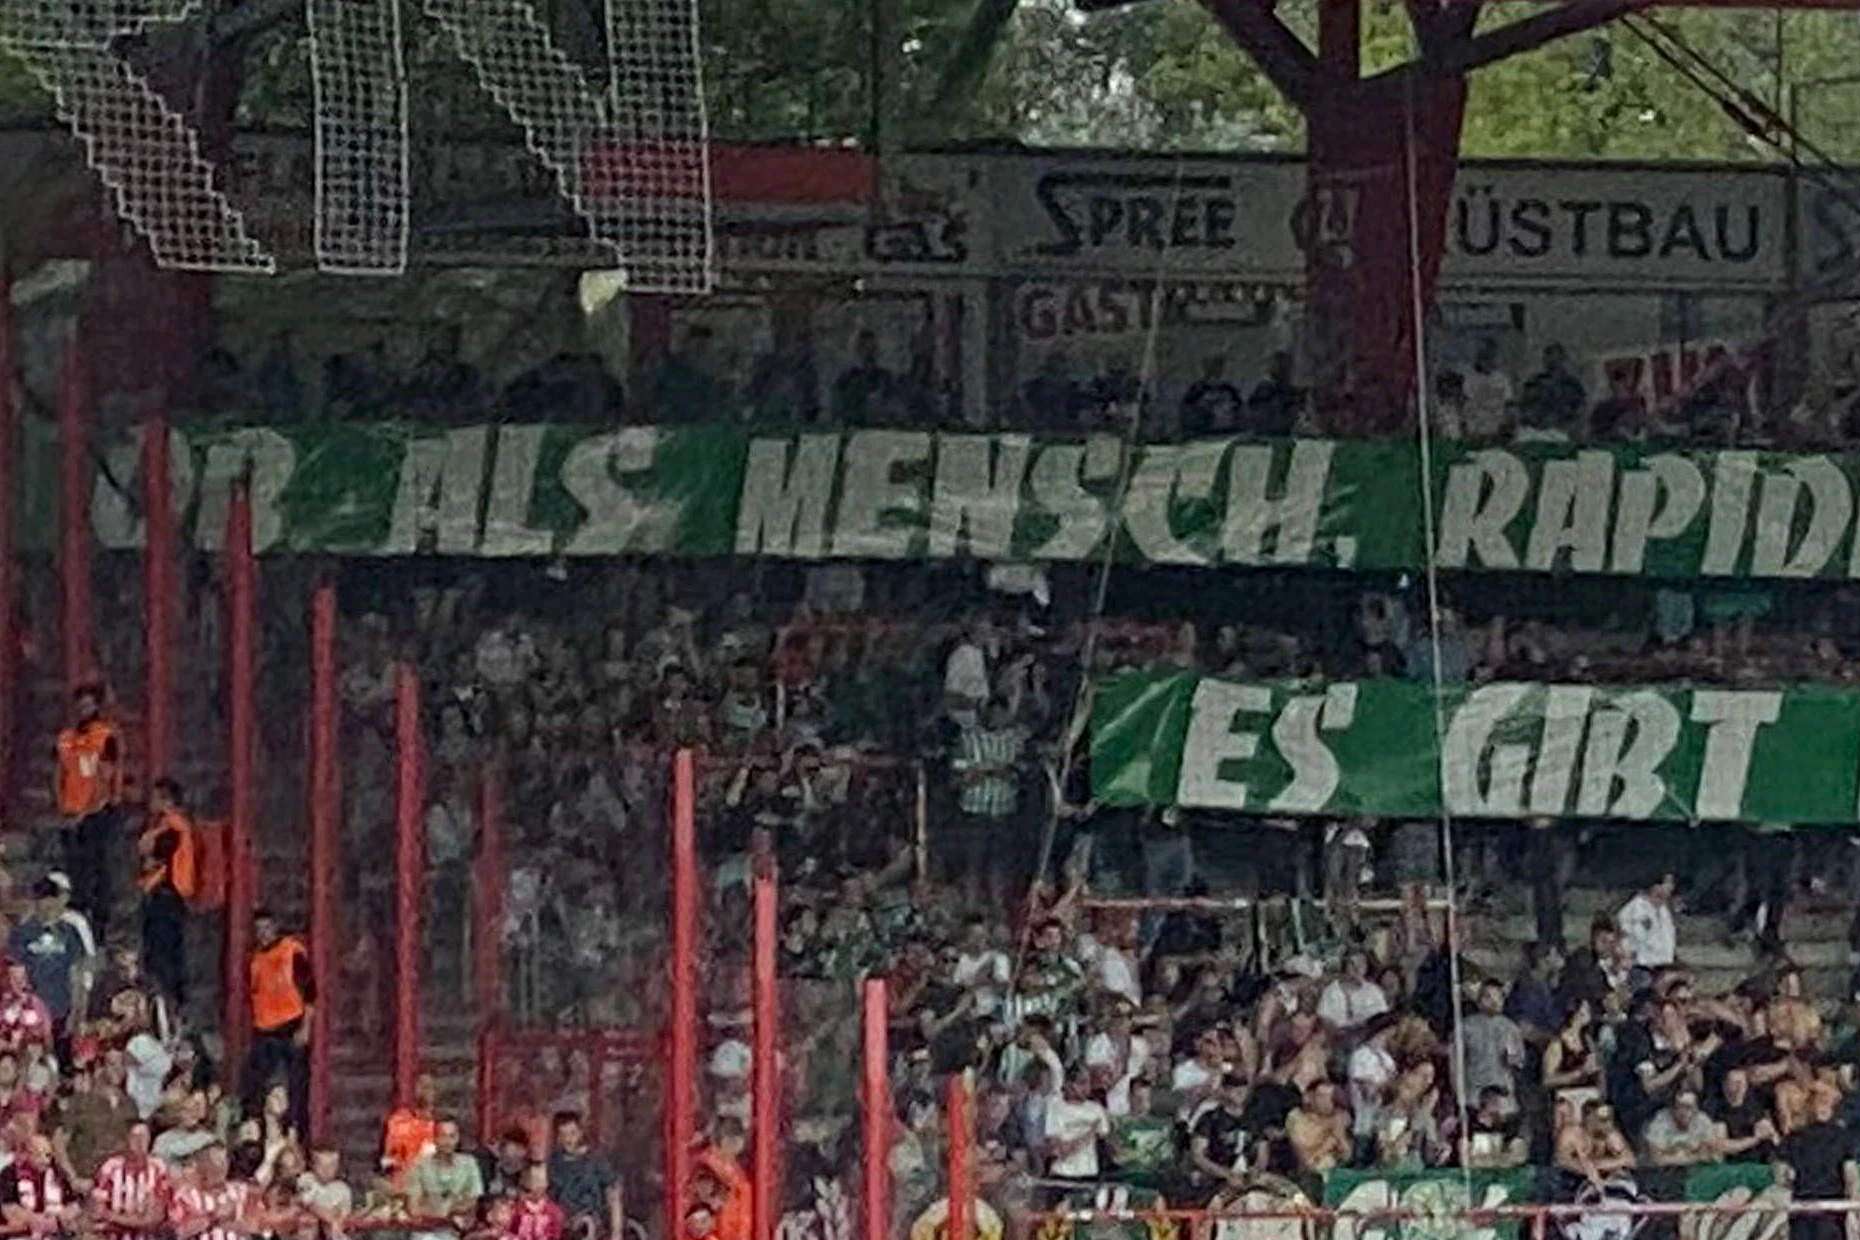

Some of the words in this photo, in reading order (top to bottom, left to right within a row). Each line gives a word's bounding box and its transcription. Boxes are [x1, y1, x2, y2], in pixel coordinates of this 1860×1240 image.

[1036, 174, 1236, 255] SPREE
[386, 422, 681, 557] ALS
[732, 428, 1358, 569] MENSCH.
[1177, 679, 1359, 812] ES
[1440, 682, 1784, 818] GIBT
